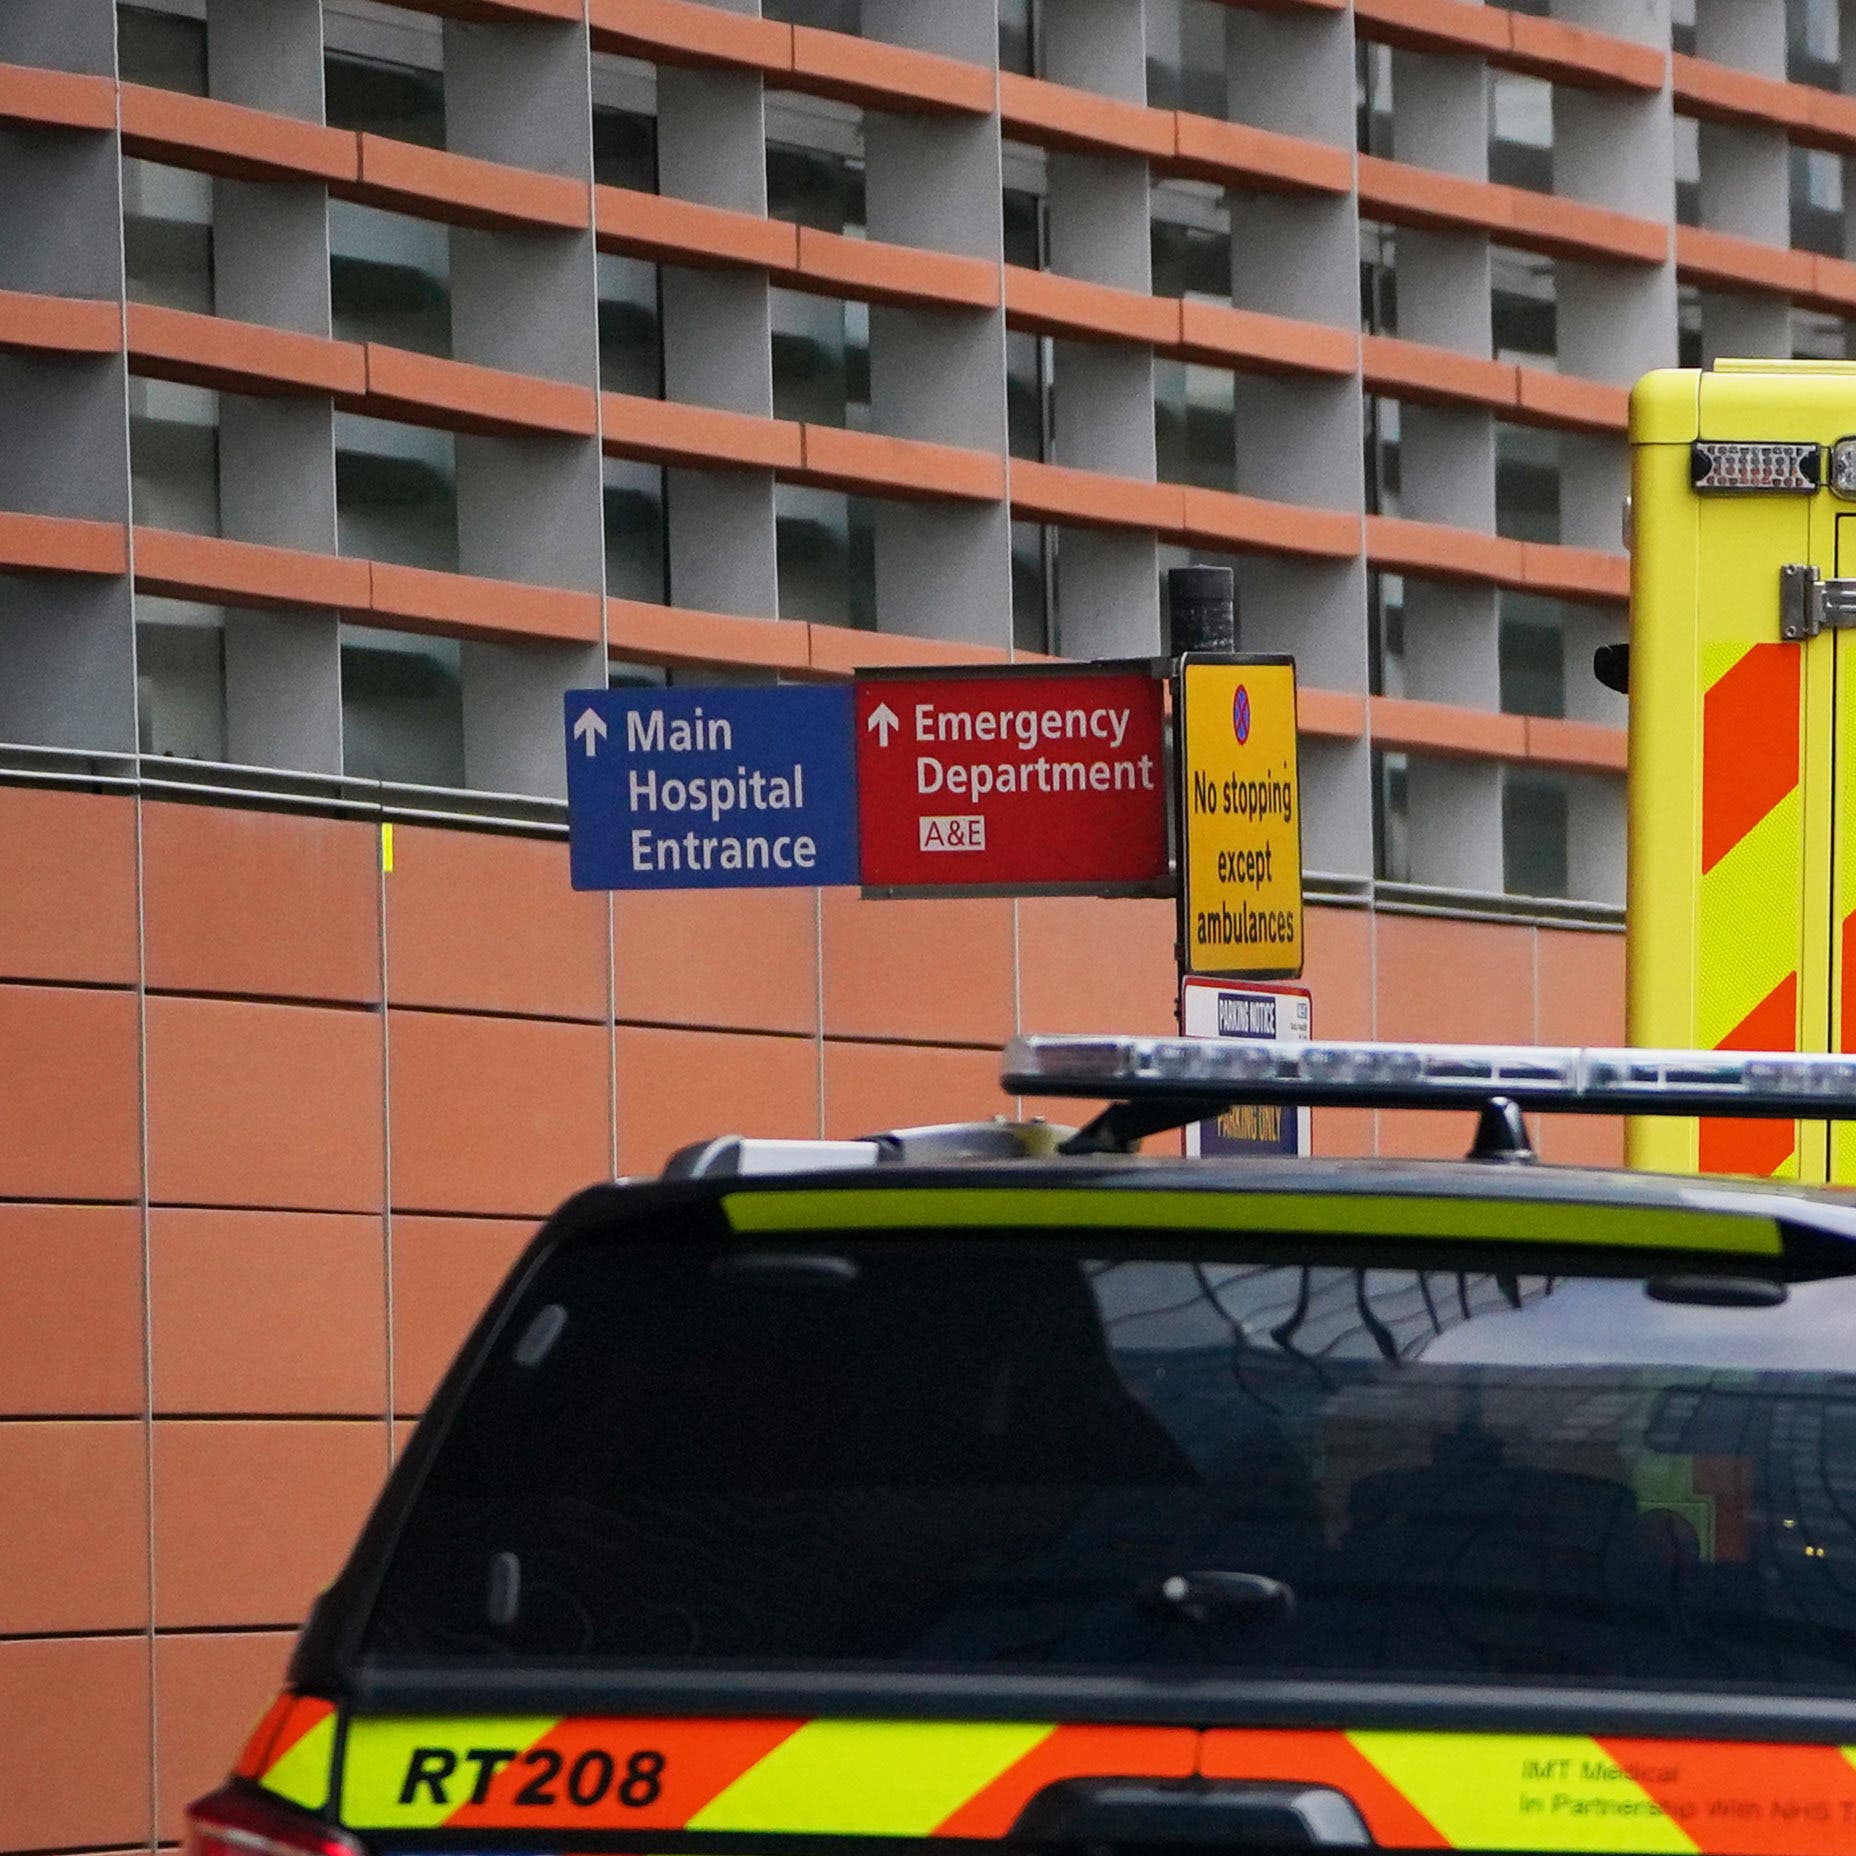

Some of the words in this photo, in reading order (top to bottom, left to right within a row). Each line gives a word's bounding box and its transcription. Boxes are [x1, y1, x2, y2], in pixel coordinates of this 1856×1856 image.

[627, 708, 732, 752] Main
[915, 704, 1130, 750] Emergency
[629, 766, 804, 820] Hospital
[917, 754, 1154, 803] Department
[1195, 770, 1218, 814] No
[1223, 767, 1293, 824] stopping
[632, 830, 817, 872] Entrance
[924, 820, 983, 849] A&E
[1217, 841, 1272, 885] except
[1198, 900, 1295, 945] ambulances
[398, 1747, 666, 1808] RT208
